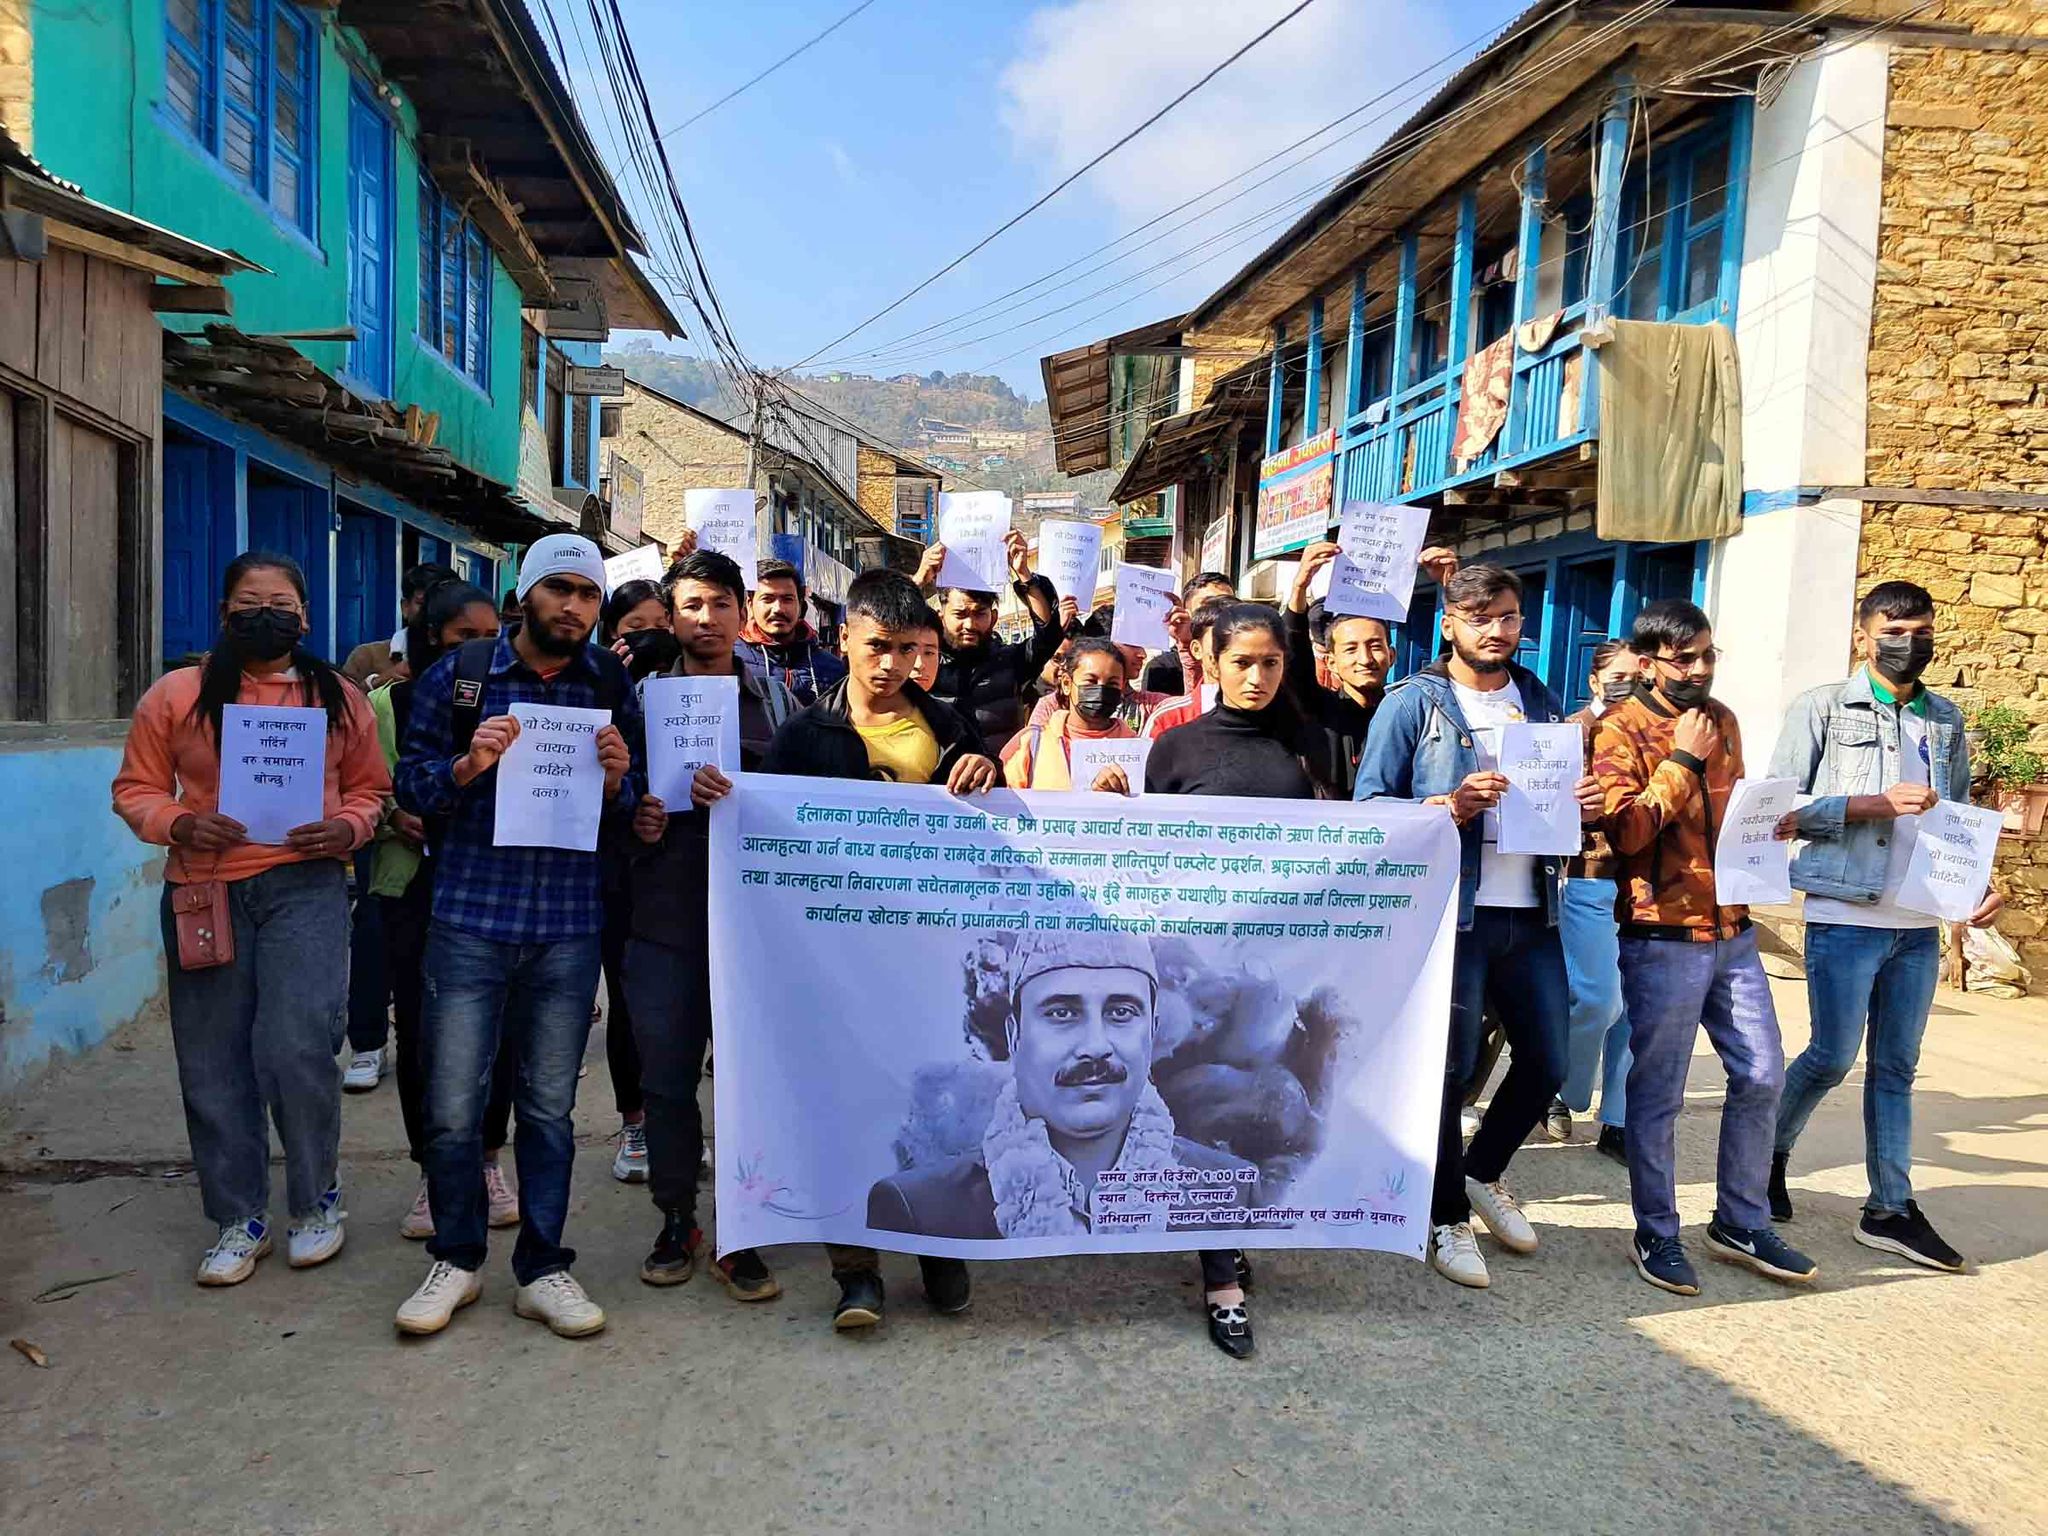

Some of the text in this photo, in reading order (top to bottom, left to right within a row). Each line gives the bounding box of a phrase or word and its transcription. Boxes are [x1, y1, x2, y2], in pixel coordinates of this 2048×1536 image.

[680, 694, 702, 709] युवा
[242, 719, 307, 731] म आत्महत्या
[523, 716, 595, 734] यो देश बस्न
[664, 713, 722, 728] स्वरोजगार
[535, 742, 576, 755] लायक
[674, 735, 714, 749] सिर्जना
[1531, 739, 1552, 752] युवा
[263, 756, 306, 768] समाधान
[533, 763, 573, 777] कहिले
[1527, 777, 1560, 791] सिर्जना
[796, 802, 1386, 845] ईलामका प्रगतिशील युवा उद्यमी स्व. प्रेम प्रसाद आचार्य तथा सप्तरीका सहकारीको ऋण तिर्न नसकि
[742, 836, 812, 857] आत्महत्या
[816, 837, 842, 856] गर्न
[944, 844, 986, 865] रामदेव
[990, 845, 1043, 865] मरिकको
[1048, 850, 1107, 867] सम्मानमा
[1111, 850, 1171, 875] शान्तिपूर्ण
[1174, 853, 1217, 871] पम्प्लेट
[1336, 858, 1369, 878] अर्पण,
[1375, 858, 1428, 878] मौनधारण
[742, 870, 770, 885] तथा
[774, 871, 844, 892] आत्महत्या
[847, 871, 912, 892] निवारणमा
[917, 875, 1001, 901] सचेतनामूलक
[1005, 881, 1032, 897] तथा
[1036, 880, 1075, 901] उहाँको
[1177, 885, 1227, 906] यथाशीघ्र
[1231, 887, 1300, 906] कार्यान्वयन
[1303, 889, 1327, 907] गर्न
[1328, 889, 1366, 908] जिल्ला
[805, 904, 863, 923] कार्यालय
[868, 905, 912, 925] खोटाङ
[916, 908, 957, 928] मार्फत
[961, 911, 1030, 930] प्रधानमन्त्री
[1034, 915, 1061, 931] तथा
[1065, 913, 1157, 935] मन्त्रीपरिषदको
[1160, 917, 1229, 936] कार्यालयमा
[1231, 922, 1286, 939] ज्ञापनपत्र
[1289, 920, 1329, 938] पठाउने
[1100, 1172, 1126, 1185] समय
[1133, 1172, 1158, 1183] आज
[1164, 1169, 1199, 1183] दिउँसो
[1237, 1169, 1256, 1182] बजे
[1099, 1193, 1127, 1205] स्थान
[1190, 1188, 1235, 1203] रत्नपार्क
[1169, 1211, 1206, 1224] स्वतन्त्र
[1252, 1207, 1304, 1222] प्रगतिशील
[1310, 1208, 1327, 1221] एवं
[1332, 1208, 1365, 1221] उद्यमी
